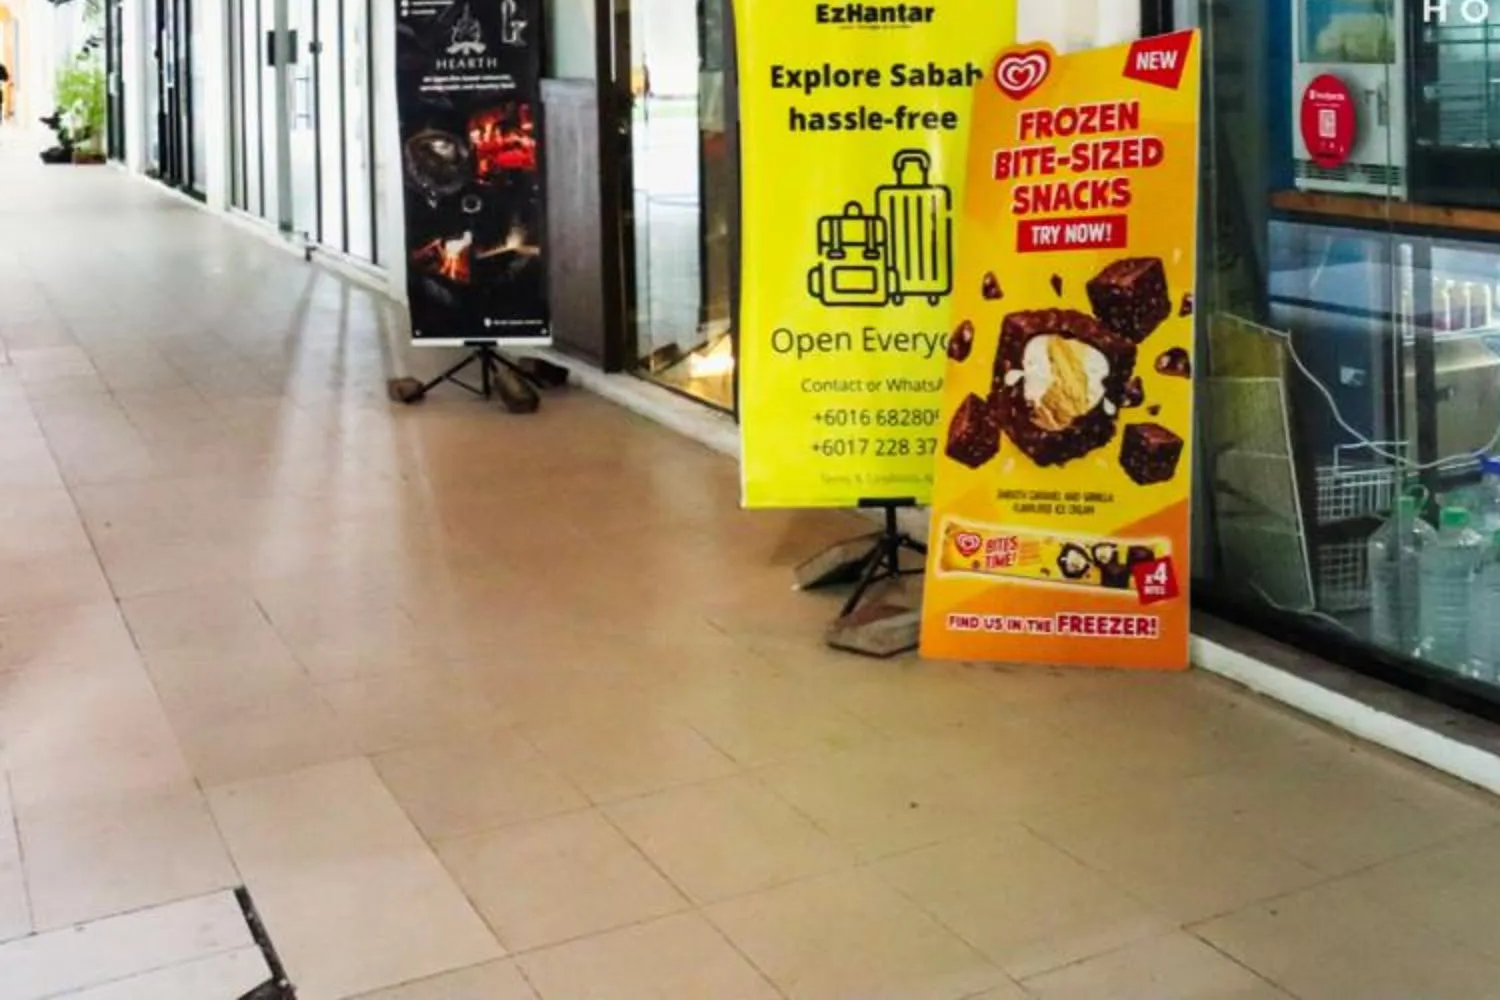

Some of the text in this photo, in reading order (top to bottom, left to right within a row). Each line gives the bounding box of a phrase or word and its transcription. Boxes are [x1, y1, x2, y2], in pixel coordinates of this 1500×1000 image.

[816, 4, 934, 23] EzHantar
[1136, 51, 1177, 70] NEW
[771, 64, 880, 95] Explore
[789, 105, 957, 131] hassle-free
[1020, 101, 1139, 140] FROZEN
[994, 137, 1163, 180] BITE-SIZED
[1012, 177, 1131, 215] SNACKS
[1031, 224, 1112, 245] TRY NOW!
[771, 328, 852, 360] Open
[801, 378, 862, 393] Contact
[866, 381, 881, 393] or
[814, 409, 871, 427] +6016
[813, 437, 869, 456] +6017
[875, 438, 909, 457] 228
[950, 616, 1157, 636] FIND US IN THE FREEZER!
